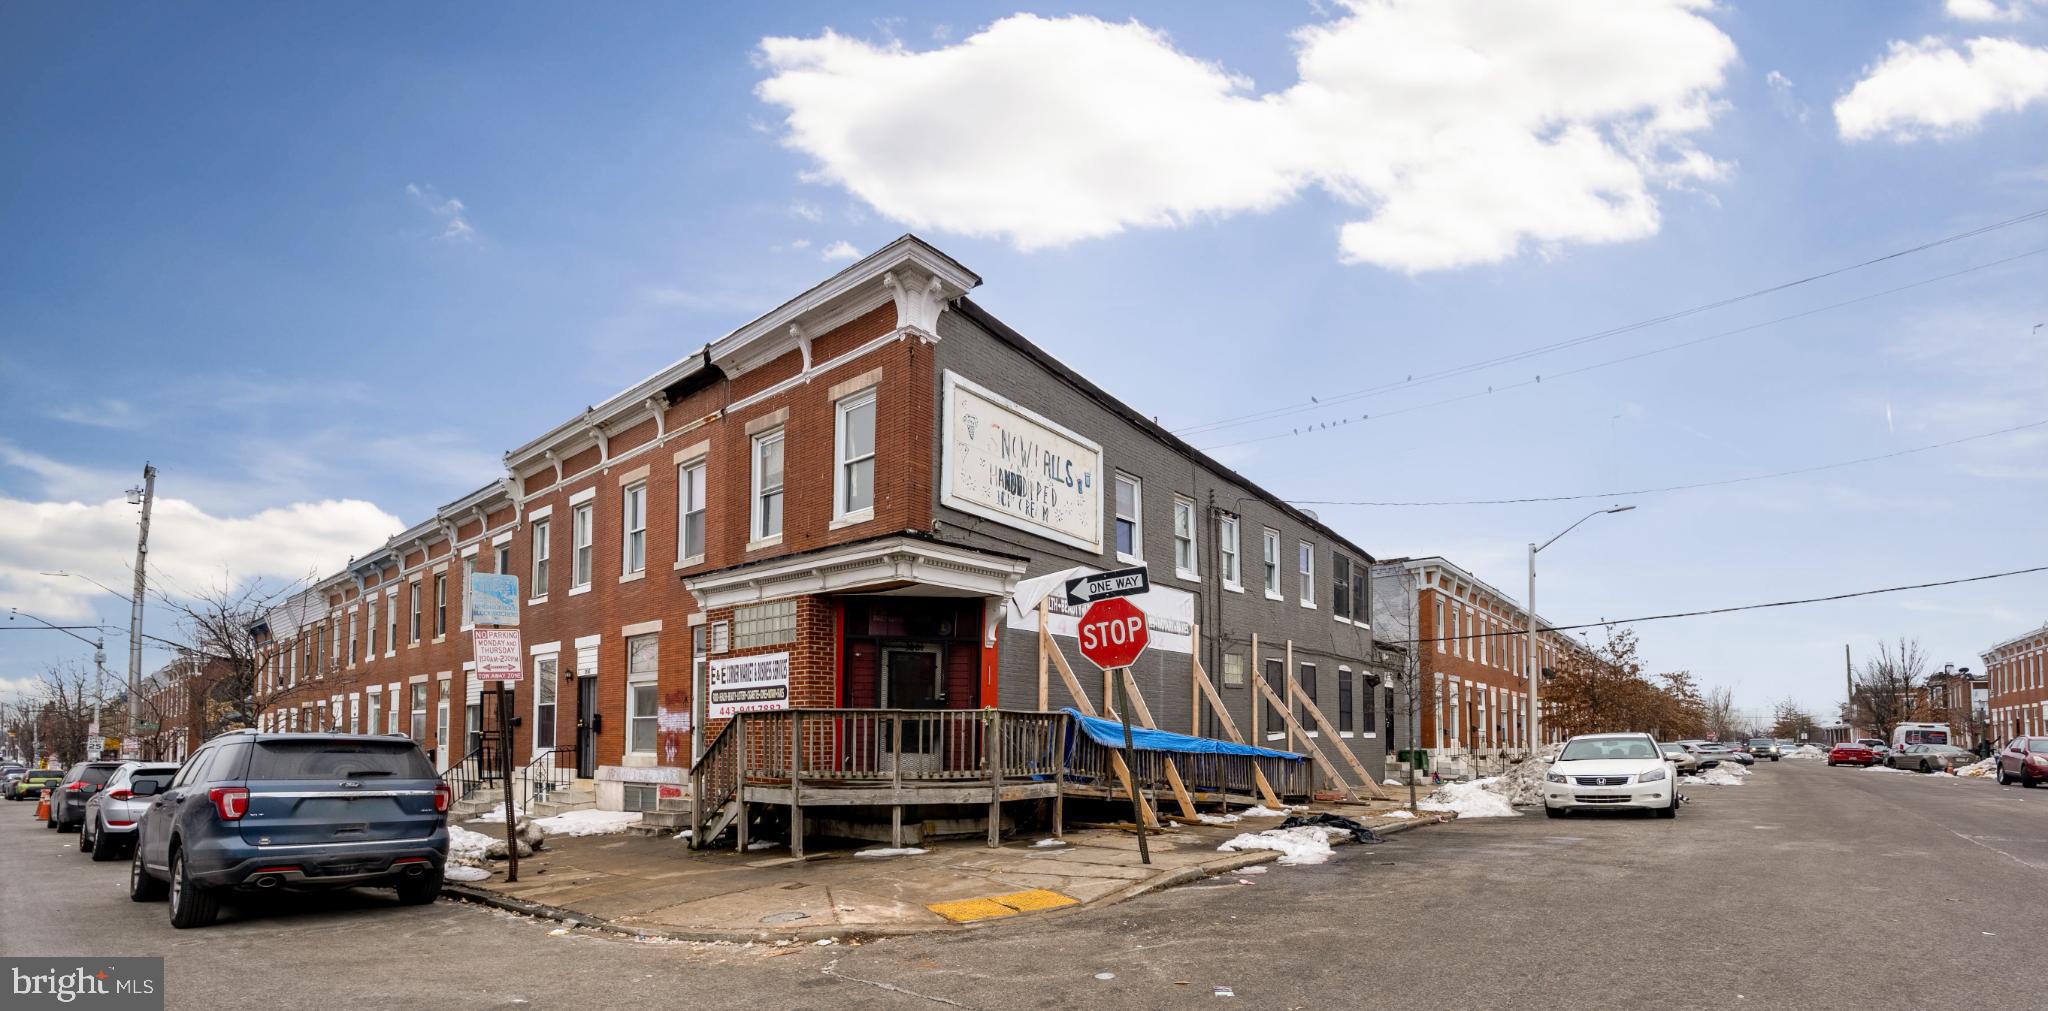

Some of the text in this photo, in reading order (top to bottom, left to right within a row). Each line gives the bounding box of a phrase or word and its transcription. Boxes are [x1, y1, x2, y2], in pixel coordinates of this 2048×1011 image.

[1090, 575, 1139, 594] ONE WAY
[475, 631, 518, 639] NO PARKING
[1083, 616, 1142, 650] STOP
[478, 639, 505, 647] MONDAY
[711, 667, 716, 685] E
[721, 667, 727, 684] E
